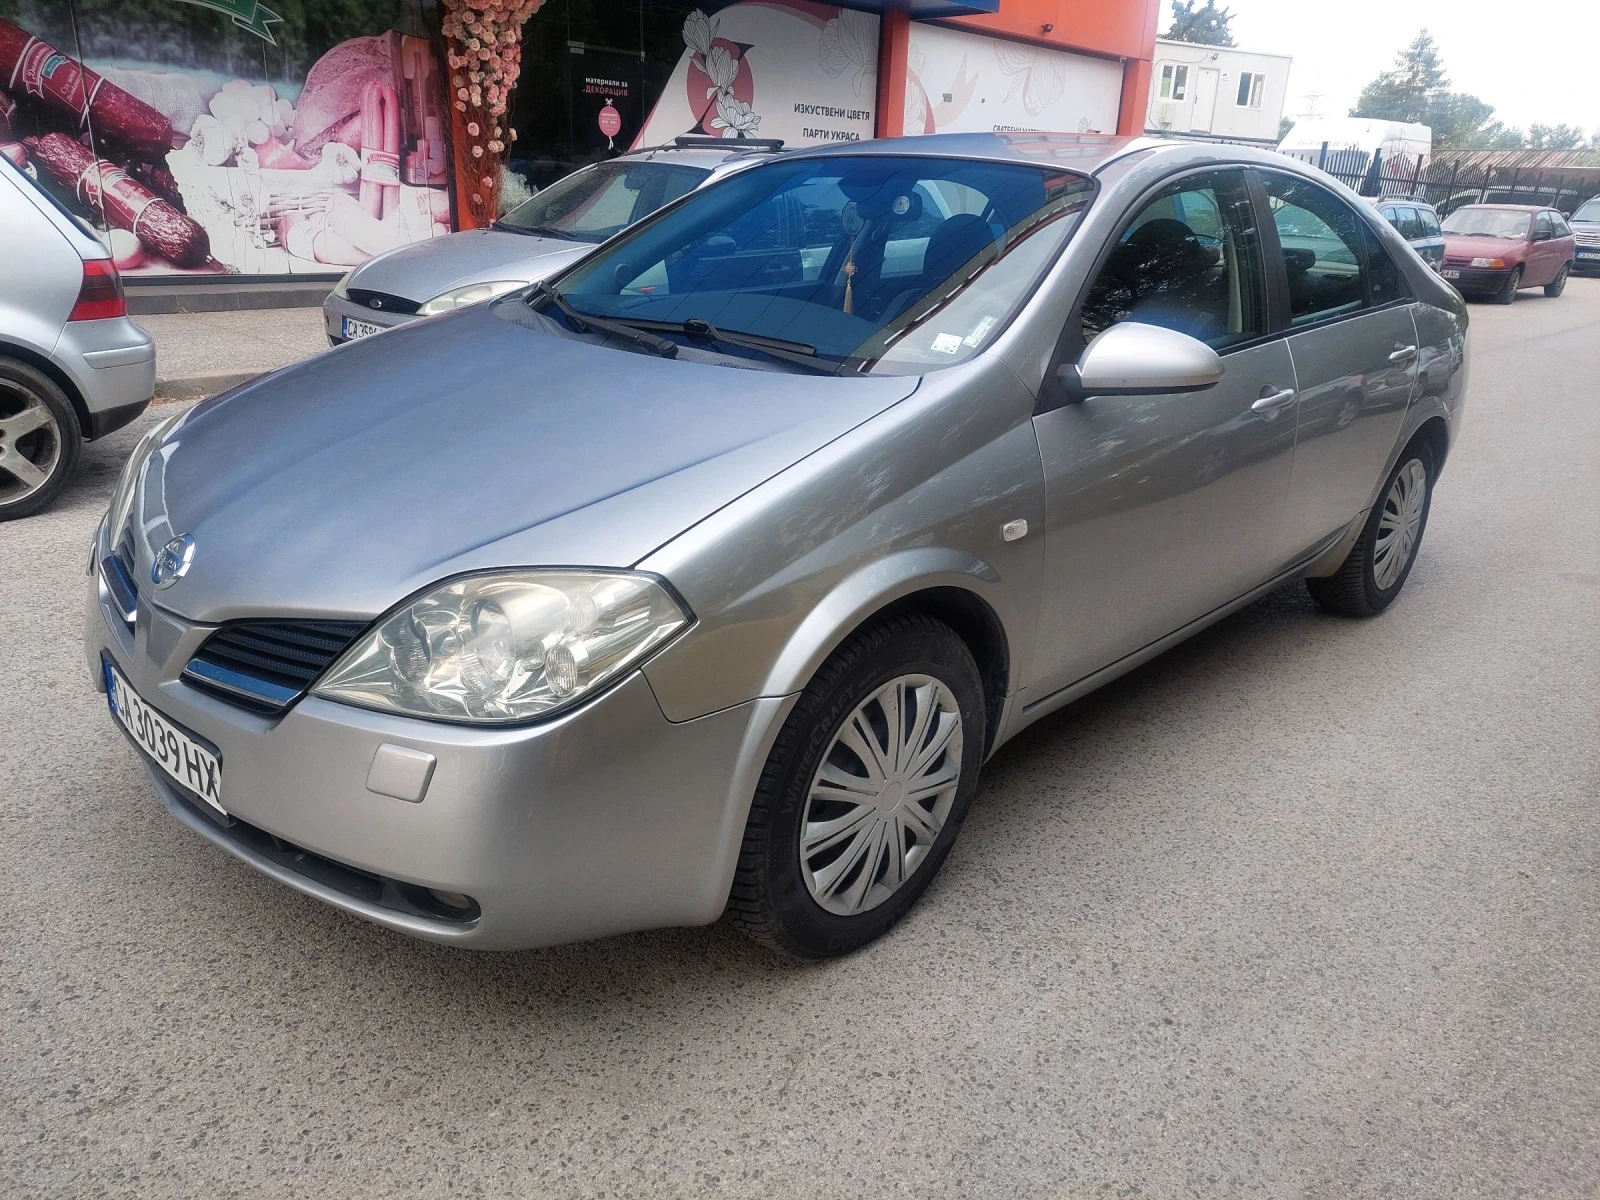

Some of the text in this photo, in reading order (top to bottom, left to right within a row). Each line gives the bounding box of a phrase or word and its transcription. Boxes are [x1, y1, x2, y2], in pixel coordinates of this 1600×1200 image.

[585, 77, 619, 86] материали
[585, 85, 628, 96] ДЕКОРАЦИЯ
[794, 103, 870, 120] ИЗКУСТВЕНИ ЦВЕТЯ
[803, 127, 860, 141] ПАРТИ УКРАСА
[348, 320, 358, 338] CA
[113, 674, 220, 803] CA 3039 HX
